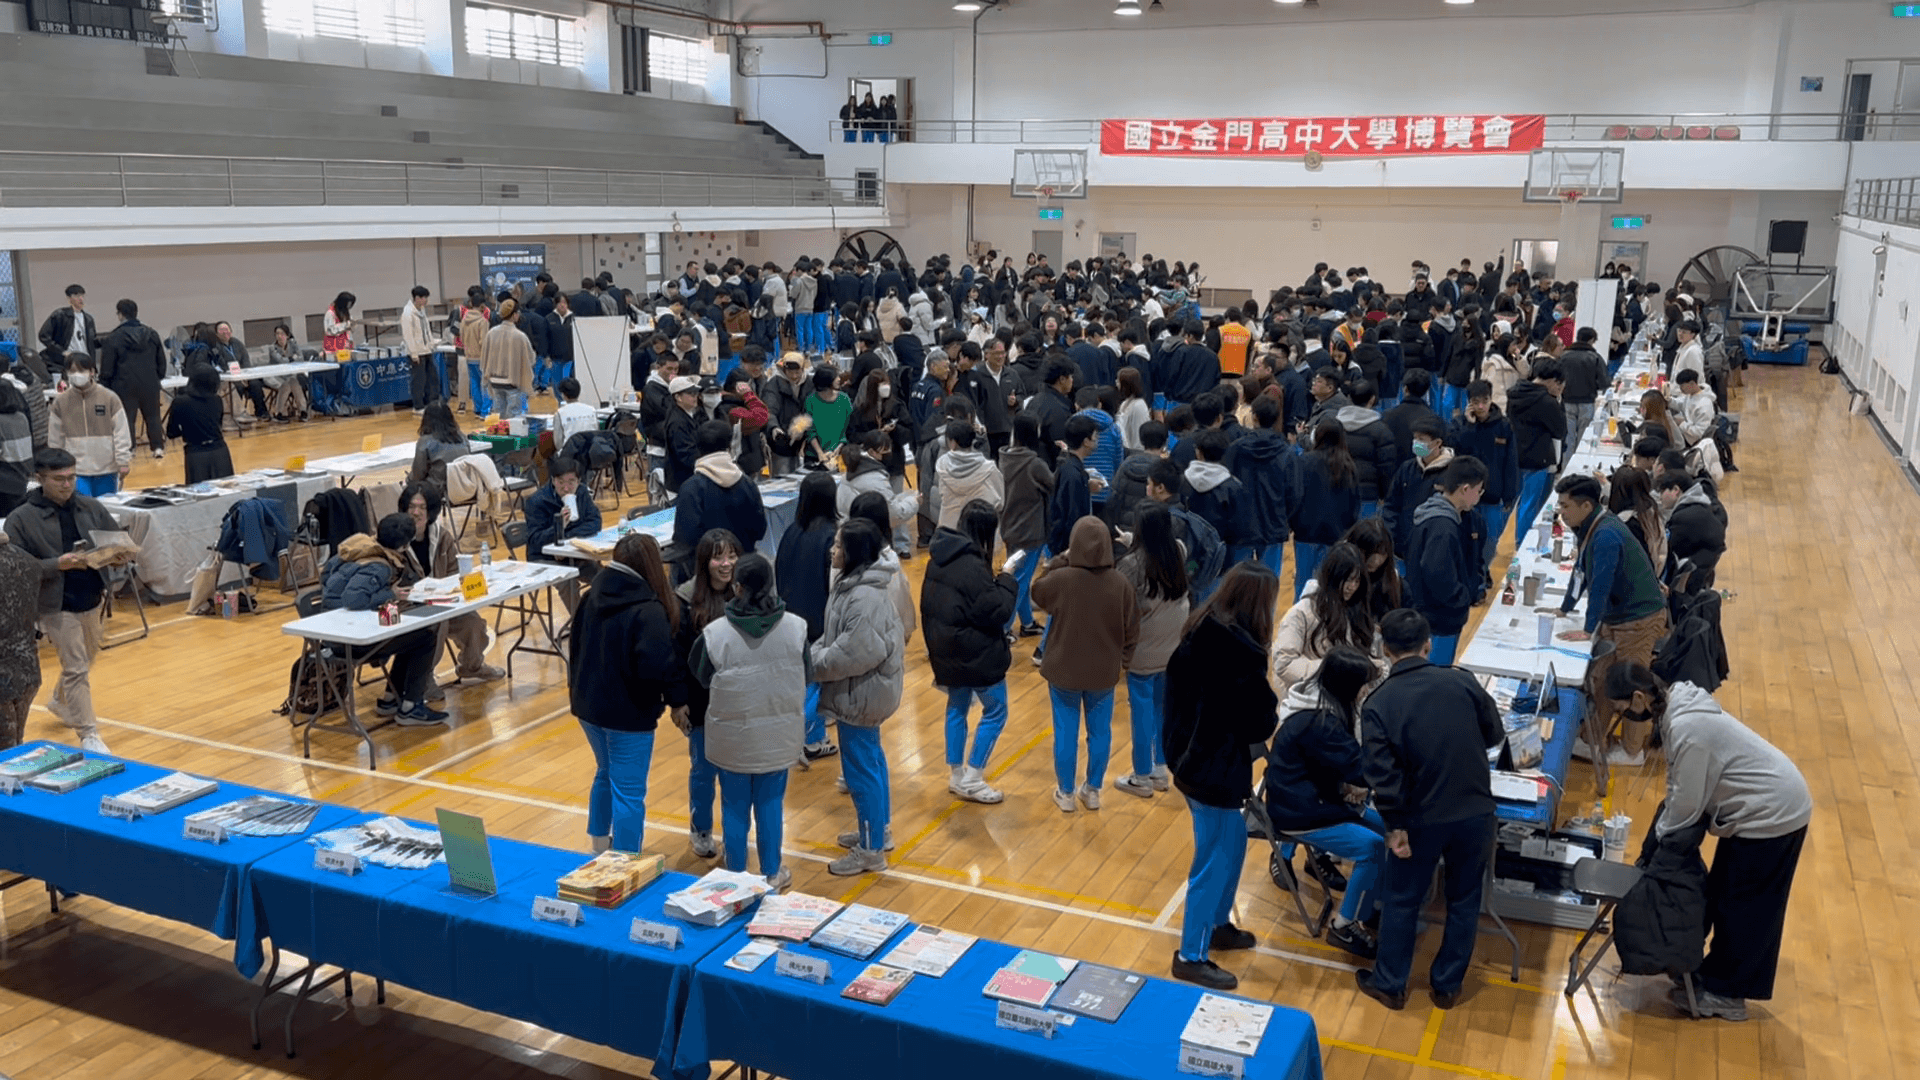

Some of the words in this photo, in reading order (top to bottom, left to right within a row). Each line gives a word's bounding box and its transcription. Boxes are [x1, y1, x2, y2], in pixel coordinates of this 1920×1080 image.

[1124, 115, 1514, 151] 國立金門高中大學博覽會
[1187, 1056, 1234, 1073] 國立高雄大學
